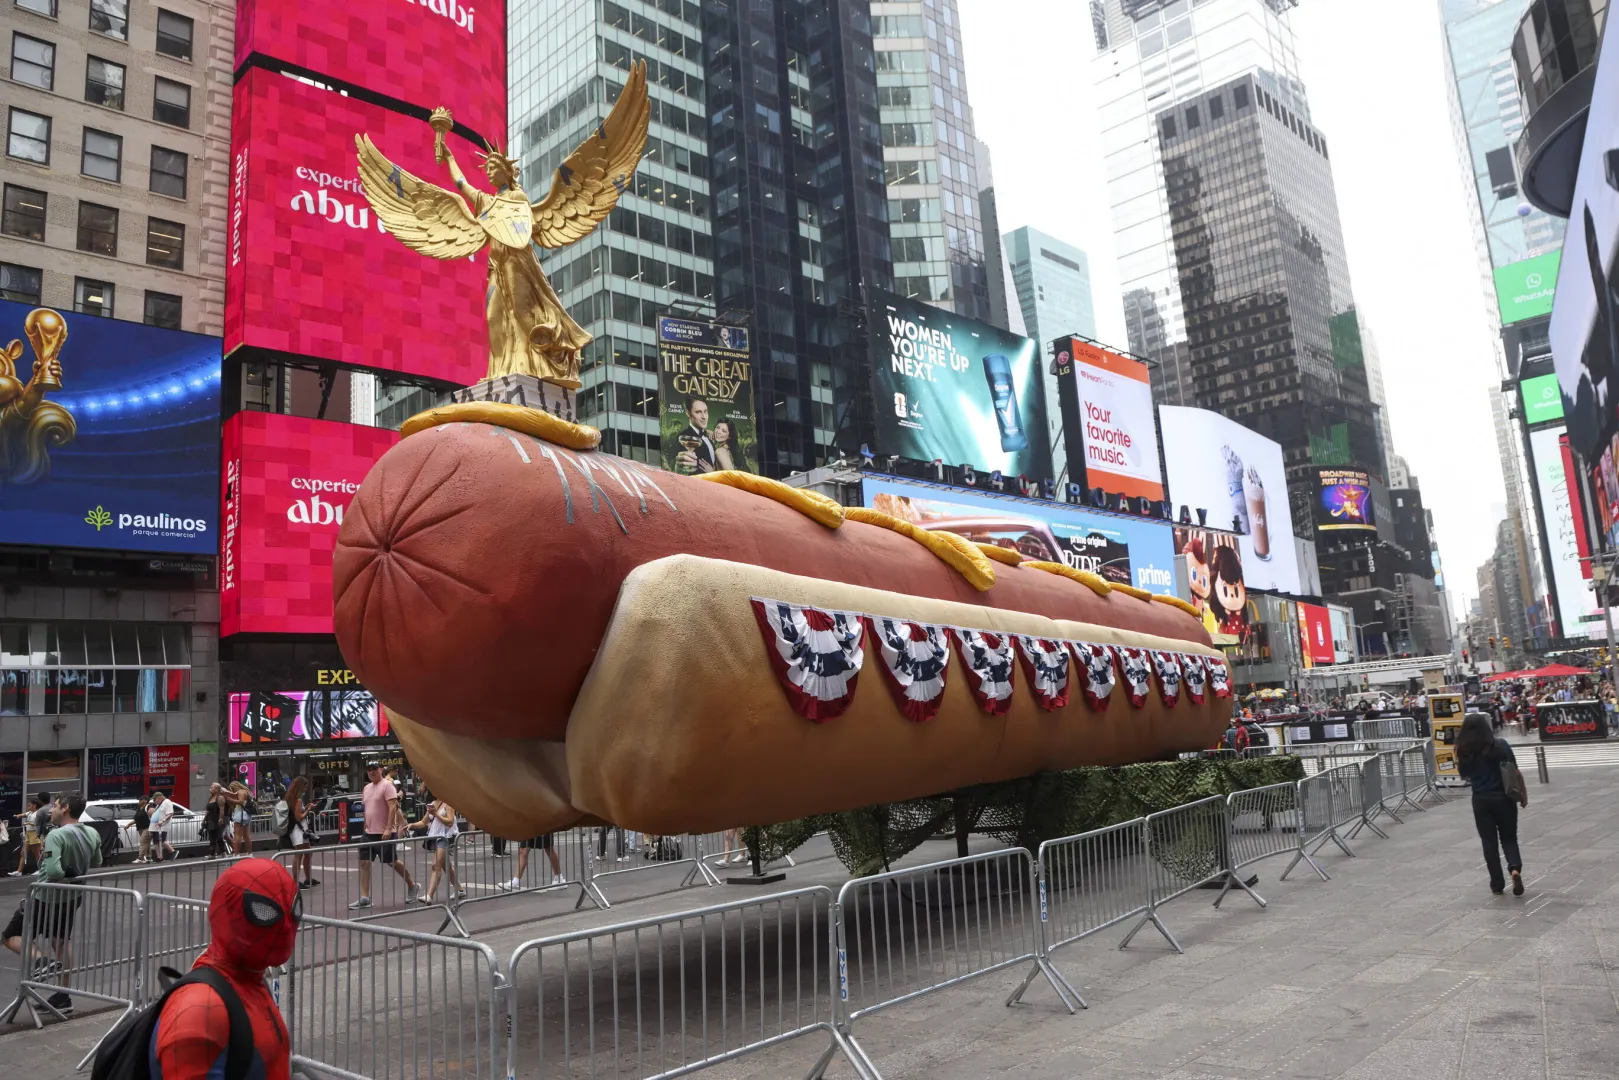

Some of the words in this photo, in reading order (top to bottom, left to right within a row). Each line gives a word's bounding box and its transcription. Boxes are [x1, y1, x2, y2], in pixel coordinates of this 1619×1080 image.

[406, 0, 475, 34] abi
[295, 166, 367, 195] experie
[290, 189, 368, 229] abu
[1513, 288, 1555, 304] WhatsAp
[664, 326, 687, 334] CORBIN
[888, 315, 956, 355] WOMEN,
[692, 347, 714, 355] ROARING
[723, 351, 750, 359] BROADWAY
[889, 334, 947, 368] YOU'RE
[951, 354, 970, 373] UP
[663, 353, 692, 374] THE
[695, 357, 750, 380] GREAT
[891, 354, 937, 383] NEXT.
[1059, 366, 1070, 376] LG
[673, 374, 741, 399] GATSBY
[1084, 400, 1111, 424] Your
[1086, 421, 1131, 448] favorite
[1089, 444, 1127, 466] music.
[118, 512, 207, 532] paulinos
[226, 514, 235, 590] dhabi
[1070, 534, 1087, 546] prime
[1087, 535, 1107, 548] original
[1367, 547, 1376, 572] 1500
[1137, 563, 1171, 588] prime
[317, 669, 361, 685] EXP
[1545, 722, 1597, 735] CHICAGO
[93, 751, 140, 776] 1560
[319, 760, 350, 770] GIFTS
[366, 757, 403, 767] LGAGE
